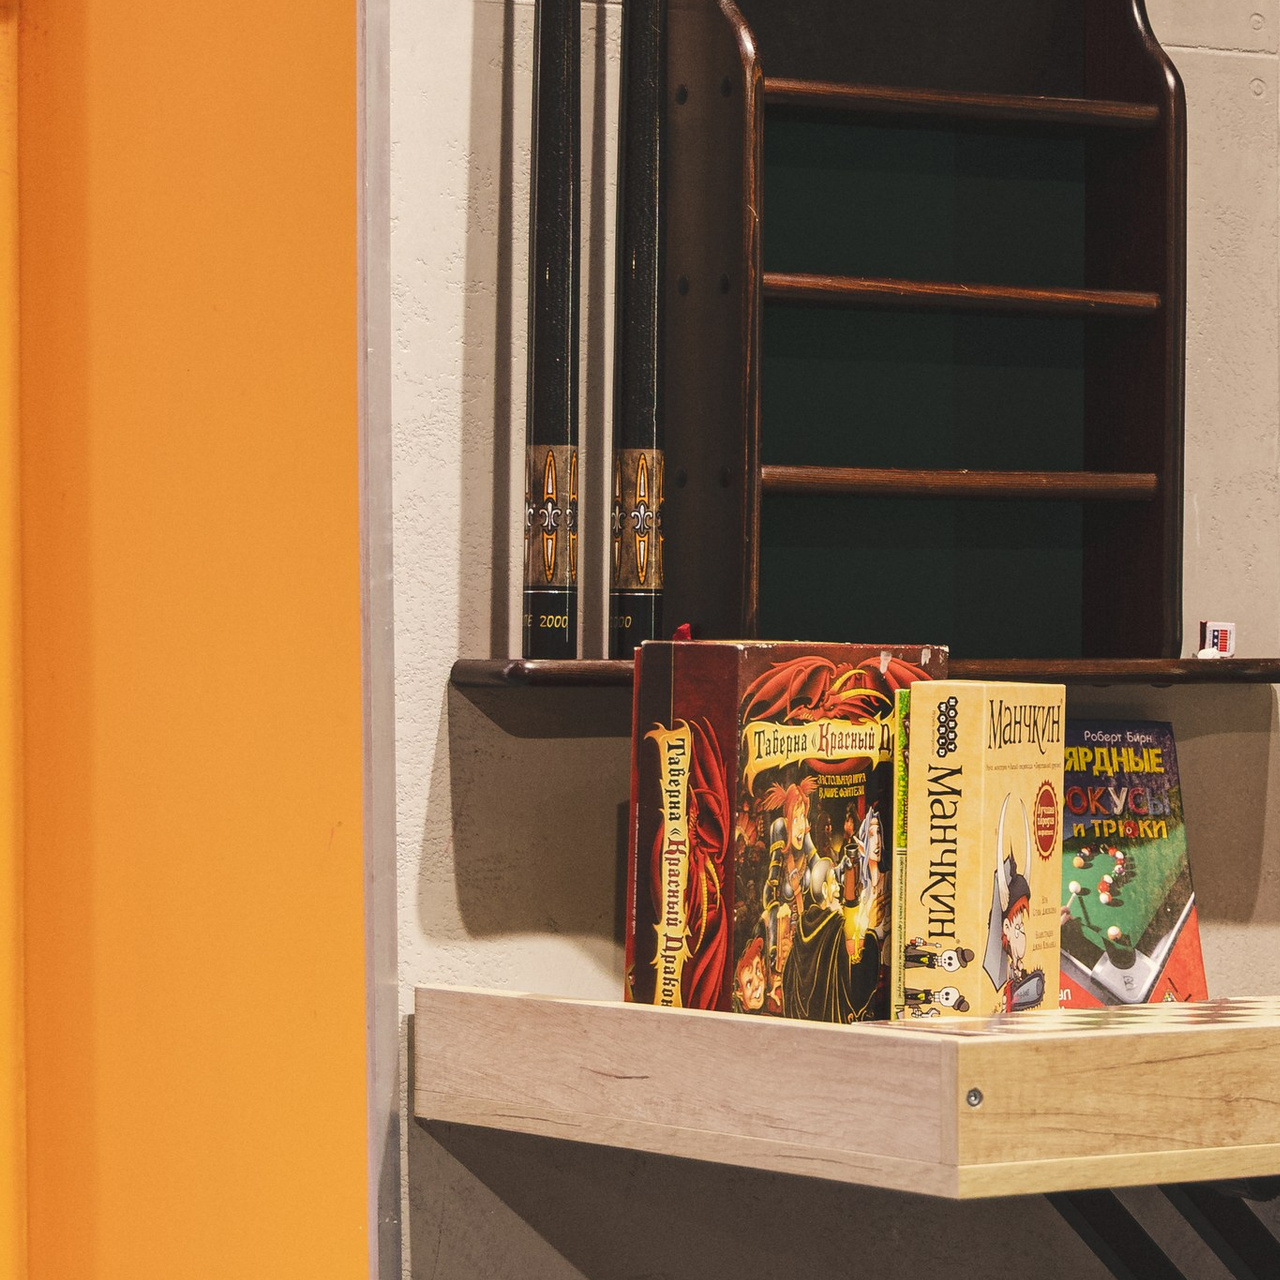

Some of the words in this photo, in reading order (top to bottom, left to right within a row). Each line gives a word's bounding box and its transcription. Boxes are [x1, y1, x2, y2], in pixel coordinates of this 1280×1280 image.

[539, 615, 569, 628] 2000
[987, 699, 1061, 756] Манчкин
[1083, 730, 1122, 745] Роберт
[1126, 731, 1153, 745] Бирн
[753, 728, 808, 762] Таверна
[1064, 745, 1165, 777] ЯРДНЫЕ
[665, 737, 687, 822] Таверна
[1063, 786, 1172, 816] ОКУСЫ
[1090, 818, 1169, 839] ТРЮКИ
[919, 762, 963, 940] Манчкин
